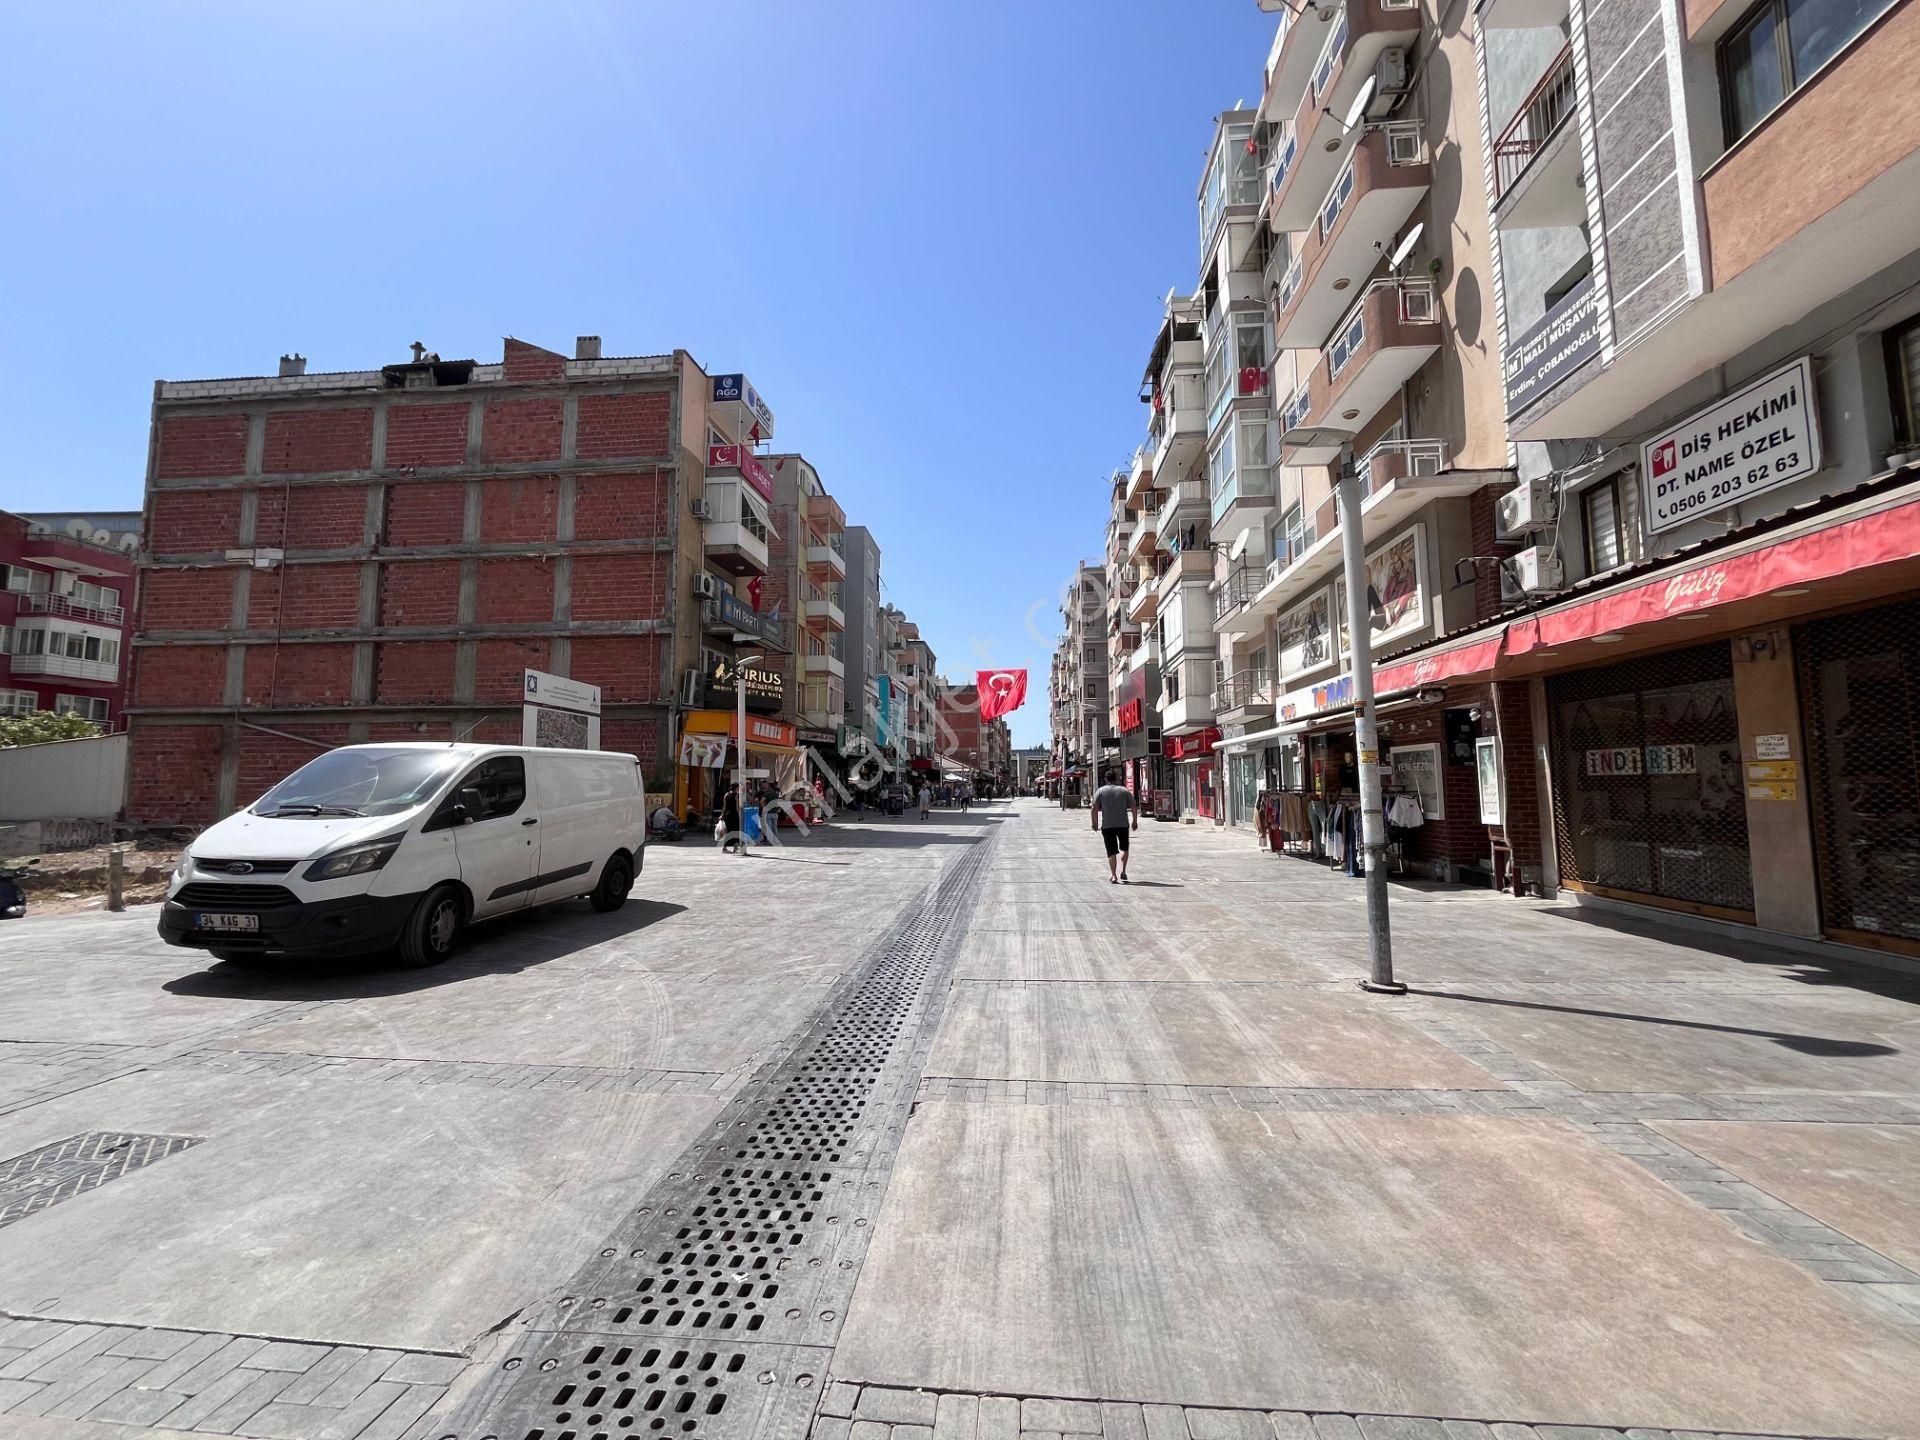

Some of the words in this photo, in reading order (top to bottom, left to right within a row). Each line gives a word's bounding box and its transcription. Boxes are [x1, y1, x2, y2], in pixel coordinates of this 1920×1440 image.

[1509, 376, 1536, 400] Erdinç
[1538, 323, 1600, 380] ÇOBANOĞLU
[1522, 325, 1551, 353] SERBEST
[1524, 337, 1548, 366] MALİ
[1681, 432, 1712, 459] DİŞ
[1718, 386, 1797, 441] HEKİMİ
[1657, 478, 1680, 498] DT.
[1685, 451, 1735, 486] NAME
[1741, 427, 1795, 460] ÖZEL
[1670, 491, 1706, 516] 0506
[1712, 476, 1742, 499] 203
[1748, 464, 1770, 484] 62
[1775, 452, 1799, 472] 63
[202, 915, 214, 925] 34
[220, 915, 238, 926] KAG
[245, 916, 256, 927] 31
